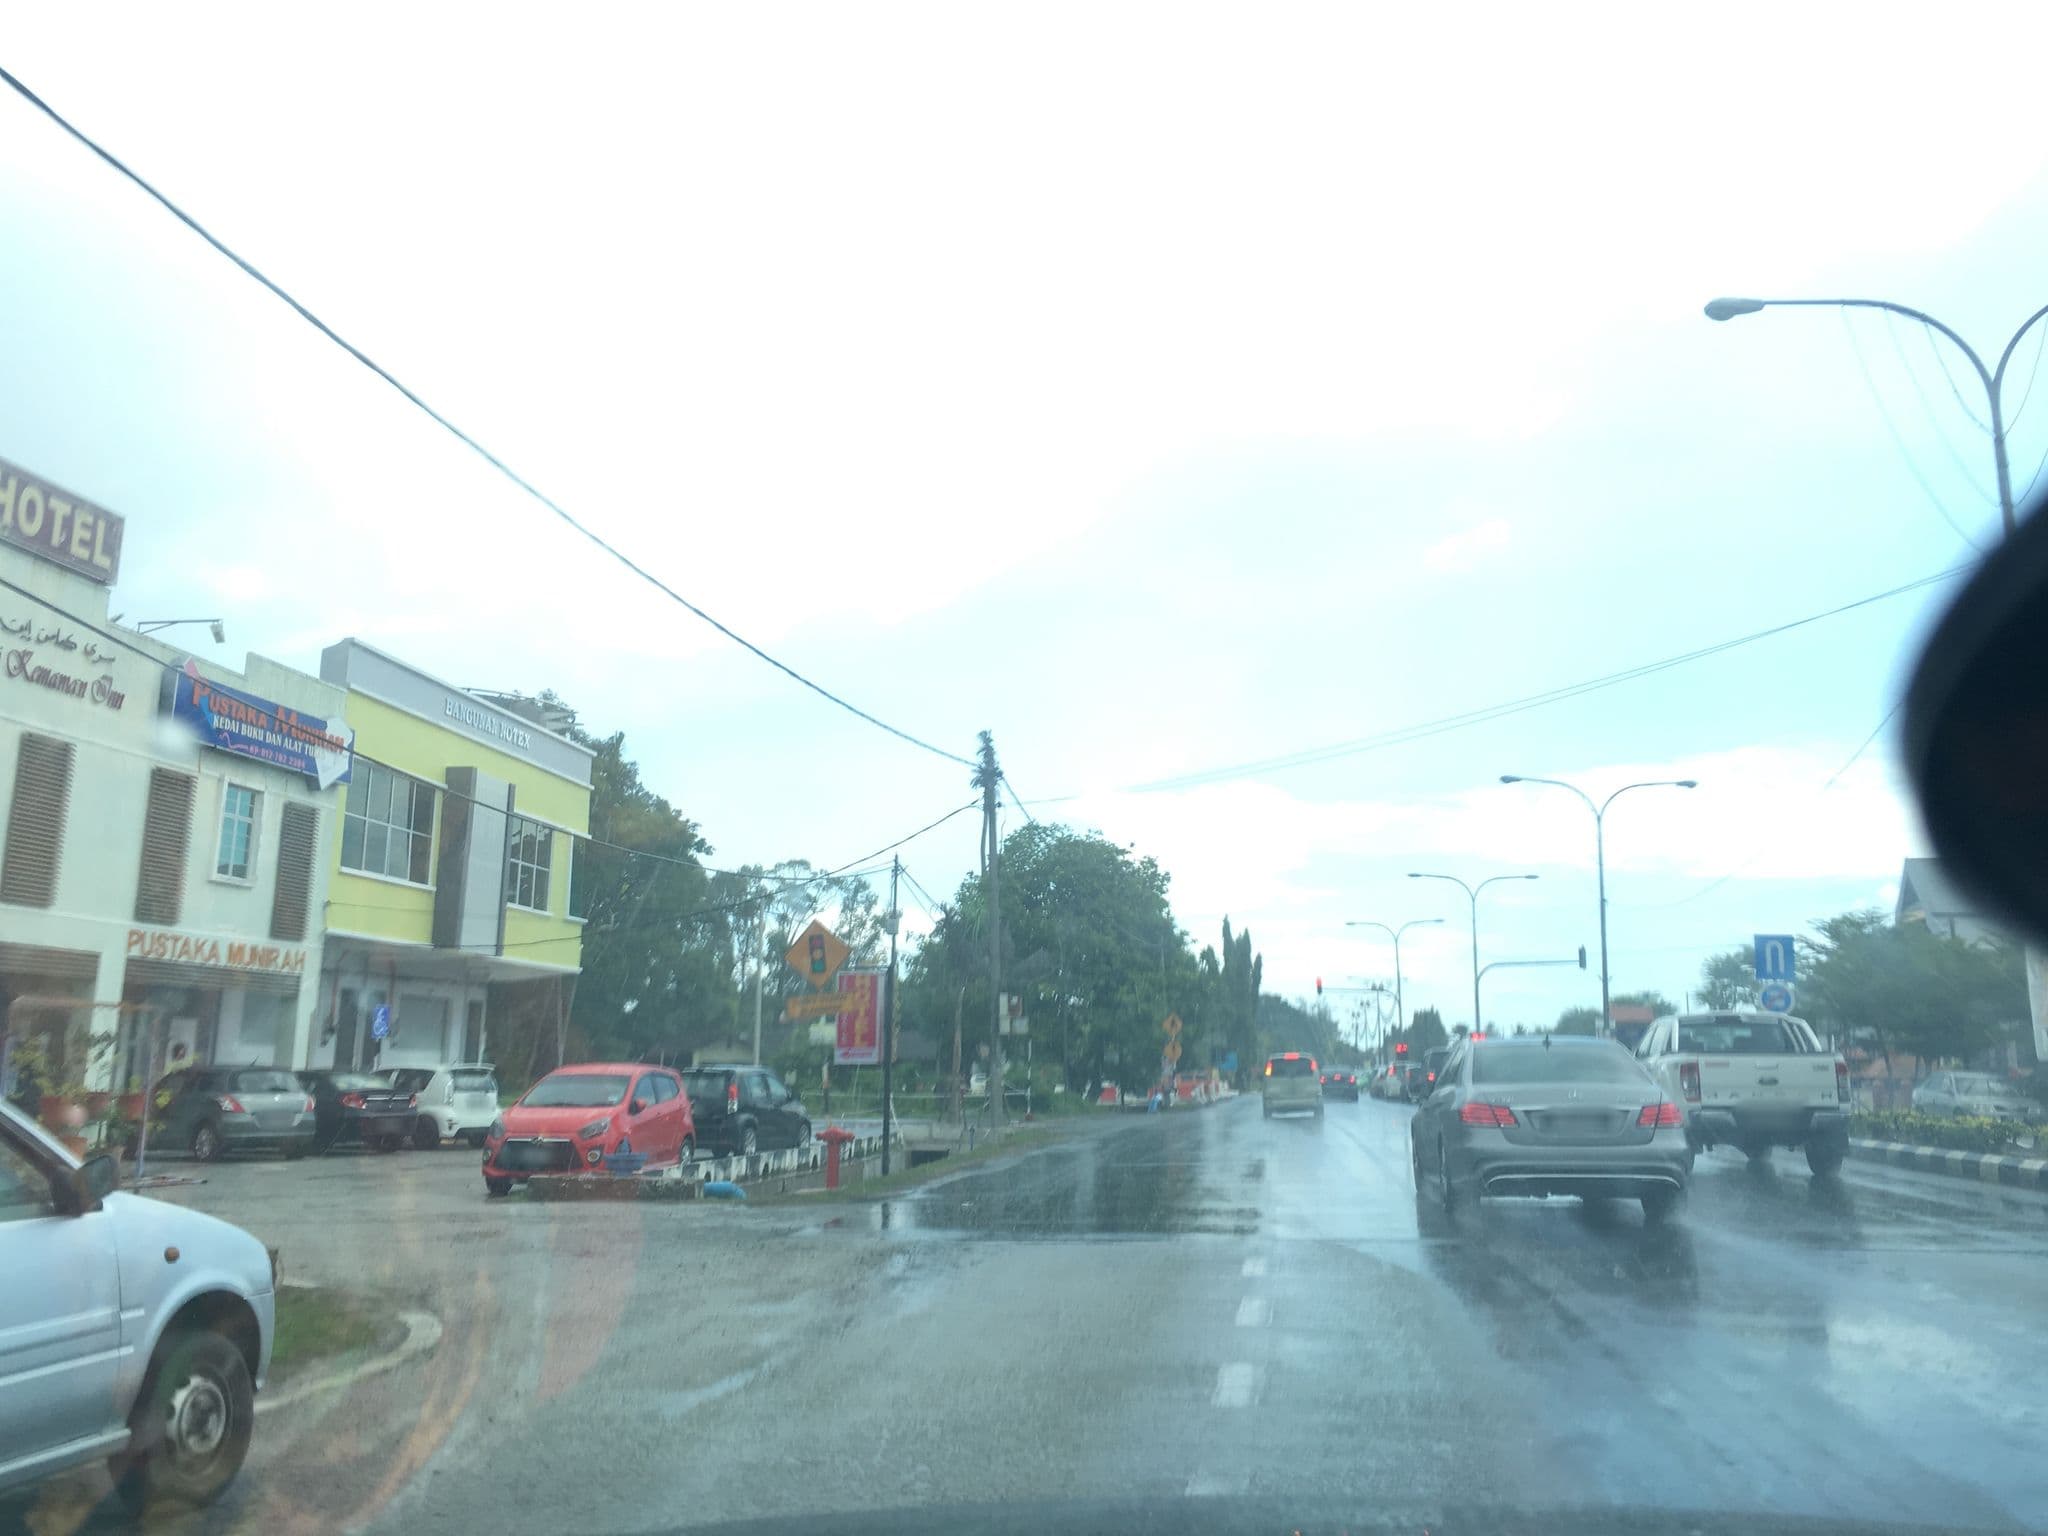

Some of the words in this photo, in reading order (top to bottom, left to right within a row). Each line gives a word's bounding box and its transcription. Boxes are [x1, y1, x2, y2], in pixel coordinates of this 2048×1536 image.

[0, 473, 112, 573] HOTEL
[6, 649, 88, 699] Kemaman
[191, 677, 268, 729] PUSTAKA
[212, 714, 239, 734] KEDAI
[241, 723, 264, 741] BUKU
[265, 730, 282, 747] DAN
[283, 737, 303, 754] ALAT
[127, 929, 221, 962] PUSTAKA
[226, 941, 307, 971] MUNIRAH
